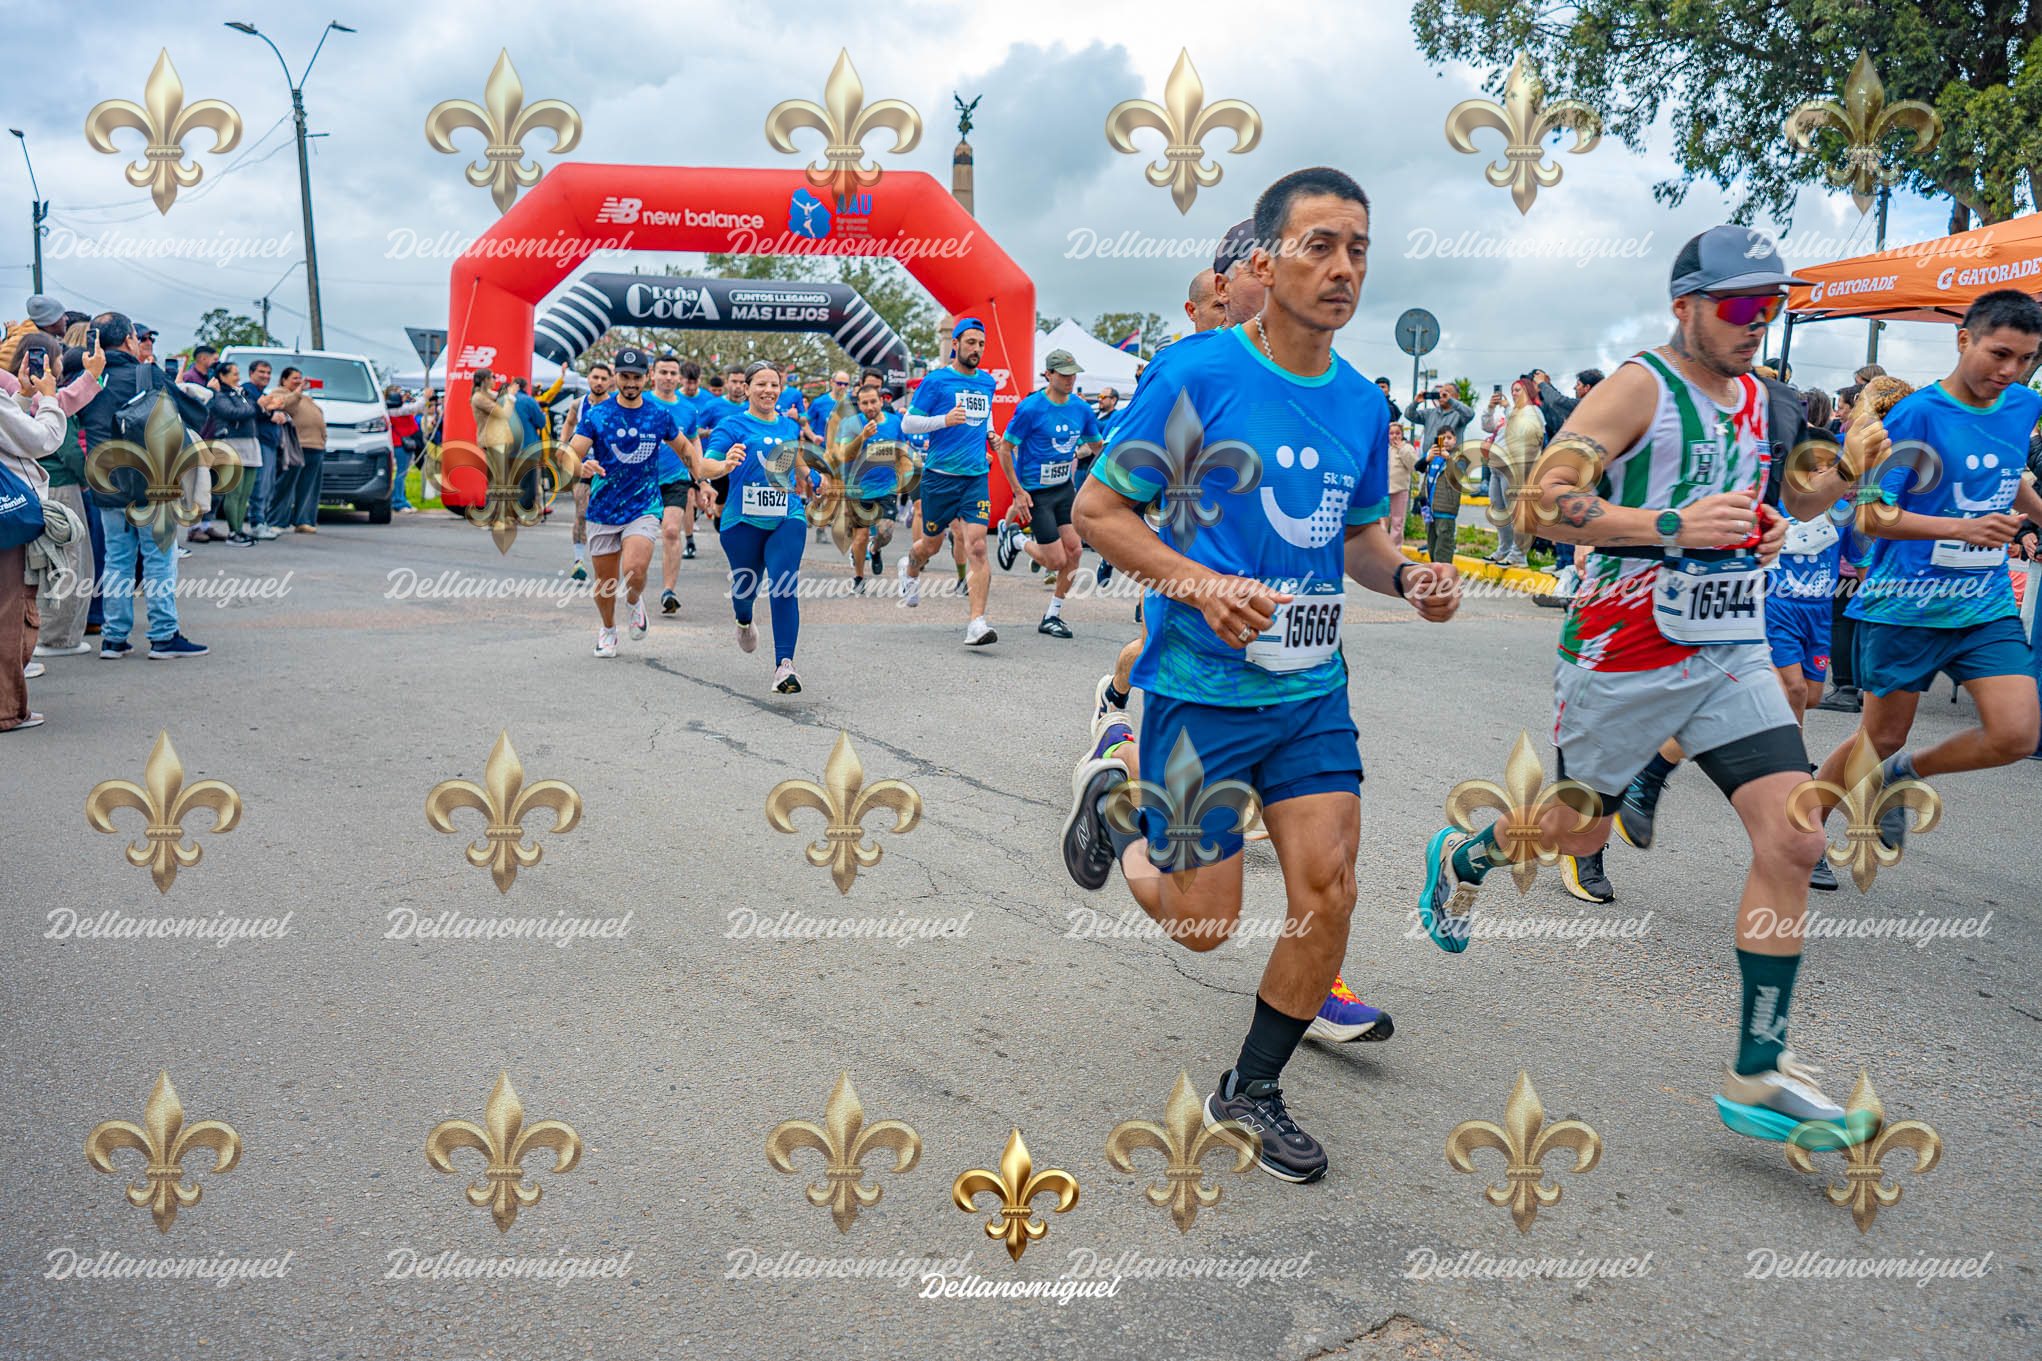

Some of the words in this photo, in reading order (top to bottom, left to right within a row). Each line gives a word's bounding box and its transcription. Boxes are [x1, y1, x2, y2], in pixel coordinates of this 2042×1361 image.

[836, 193, 872, 215] AAU
[642, 210, 681, 225] new
[684, 208, 764, 229] balance
[1958, 256, 2042, 286] GATORADE
[1827, 275, 1898, 297] GATORADE
[735, 293, 775, 303] JUNTOS
[775, 294, 826, 304] LLEGAMOS
[731, 305, 775, 321] MÁS
[775, 307, 829, 322] LEJOS
[965, 397, 986, 411] 15697
[756, 489, 787, 507] 16522
[1688, 579, 1757, 620] 16544
[1284, 602, 1342, 649] 15668
